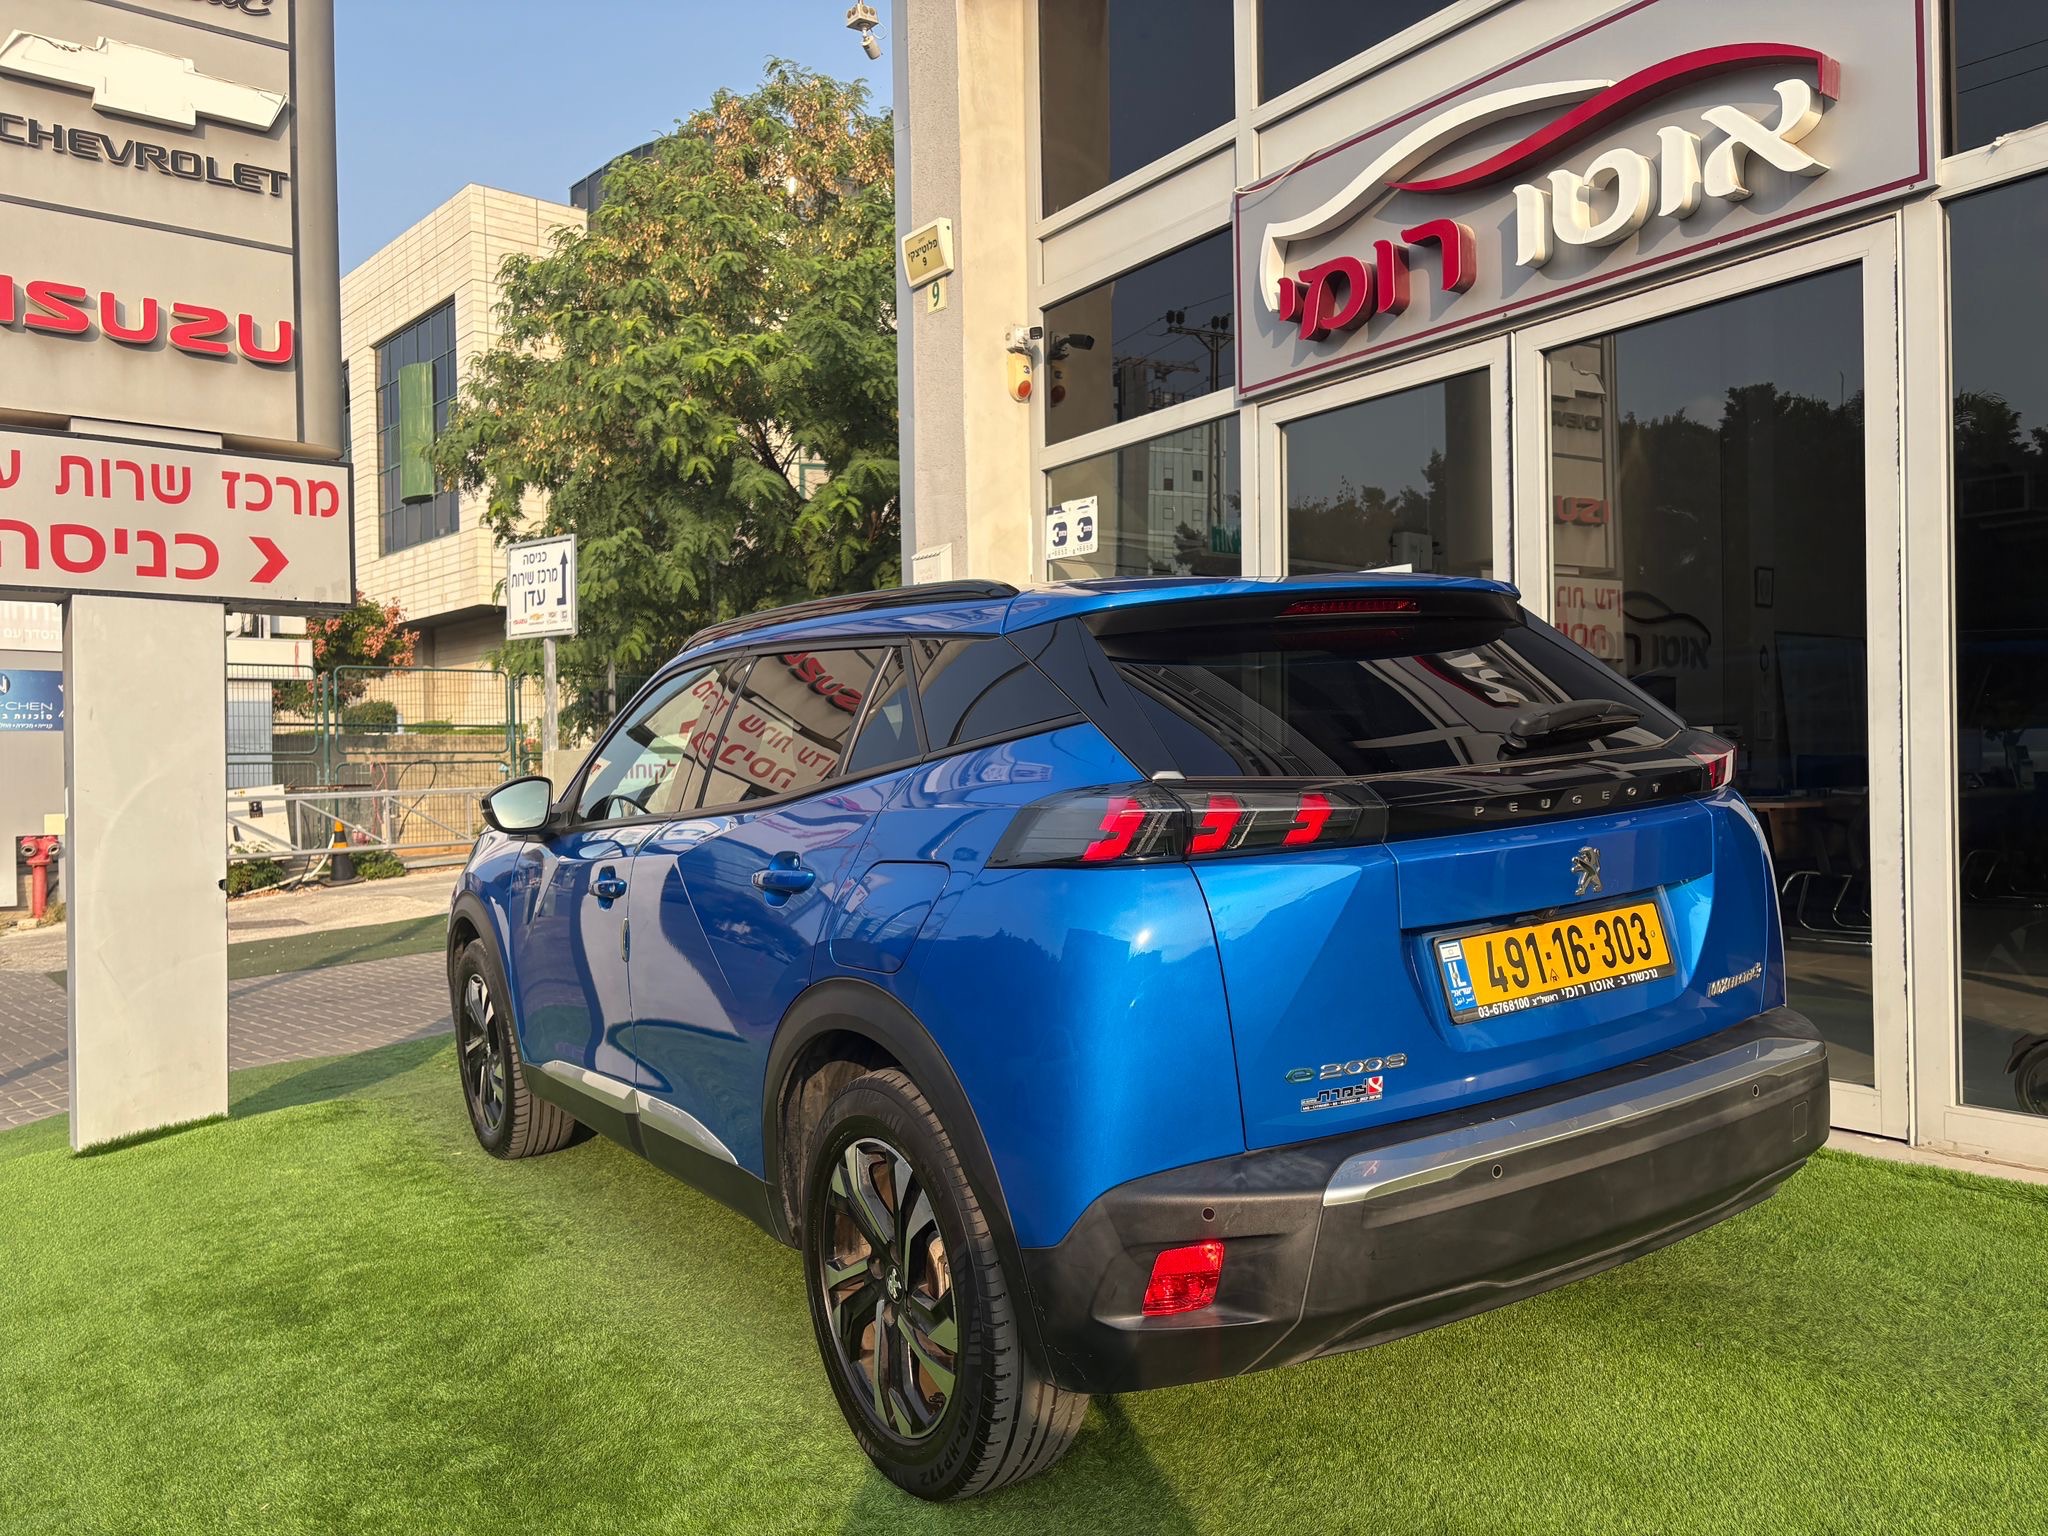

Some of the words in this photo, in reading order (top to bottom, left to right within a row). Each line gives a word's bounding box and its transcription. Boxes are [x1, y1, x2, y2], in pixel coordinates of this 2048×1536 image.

[0, 112, 288, 197] CHEVROLET
[1512, 77, 1831, 269] אוטו
[922, 256, 928, 266] 9
[1278, 218, 1478, 343] רומי
[932, 282, 940, 307] 9
[0, 274, 294, 365] ISUZU
[55, 455, 191, 505] שרות
[221, 470, 340, 518] מרכז
[0, 518, 219, 580] כניסה
[523, 551, 547, 565] כניסה
[511, 570, 534, 588] שירות
[537, 567, 558, 584] מרכז
[524, 588, 546, 613] עדן
[1474, 782, 1662, 817] PEUGEOT
[1589, 977, 1615, 993] אוטו
[1627, 968, 1659, 983] נרכשתי
[1560, 983, 1586, 999] רומי
[1477, 996, 1530, 1018] 03-6768100
